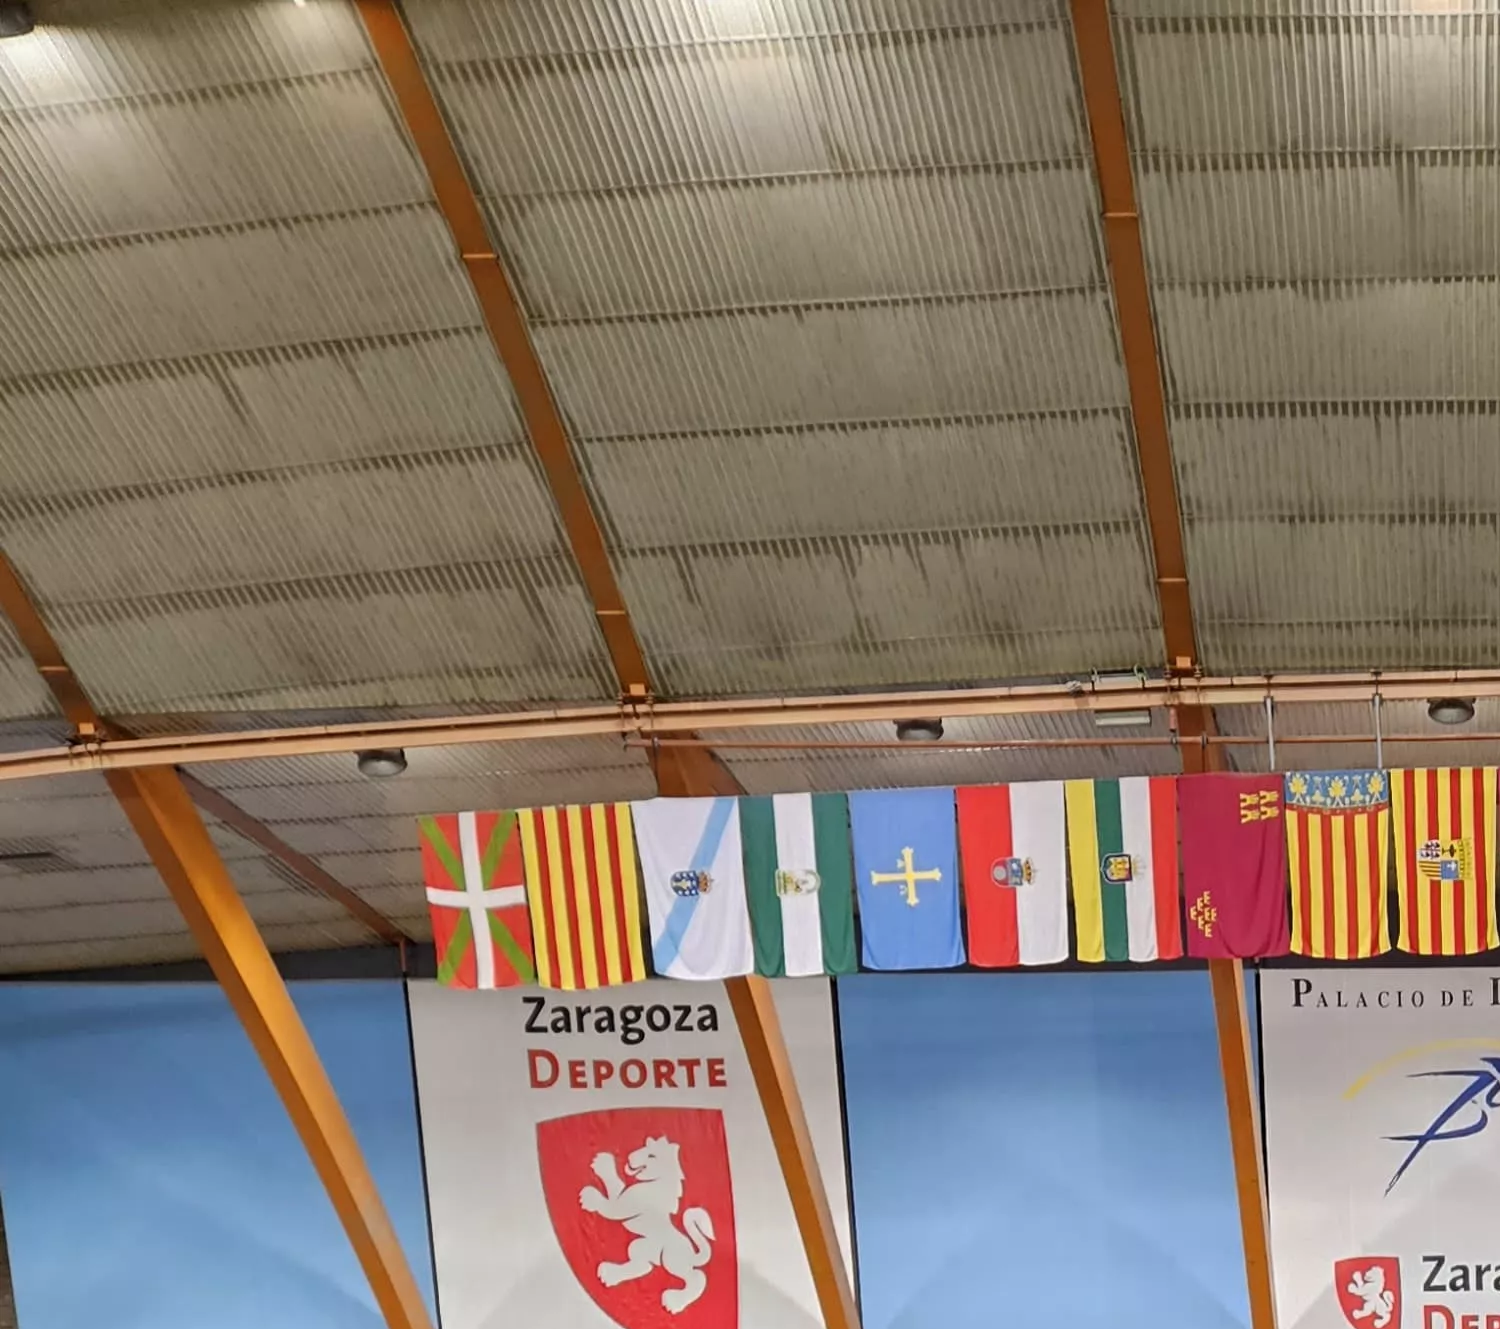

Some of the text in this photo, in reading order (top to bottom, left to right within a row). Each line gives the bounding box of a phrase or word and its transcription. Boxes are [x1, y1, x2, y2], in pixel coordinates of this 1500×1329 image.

[1291, 978, 1425, 1008] PALACIO
[1440, 989, 1475, 1007] DE
[522, 996, 719, 1045] Zaragoza
[527, 1049, 727, 1088] DEPORTE
